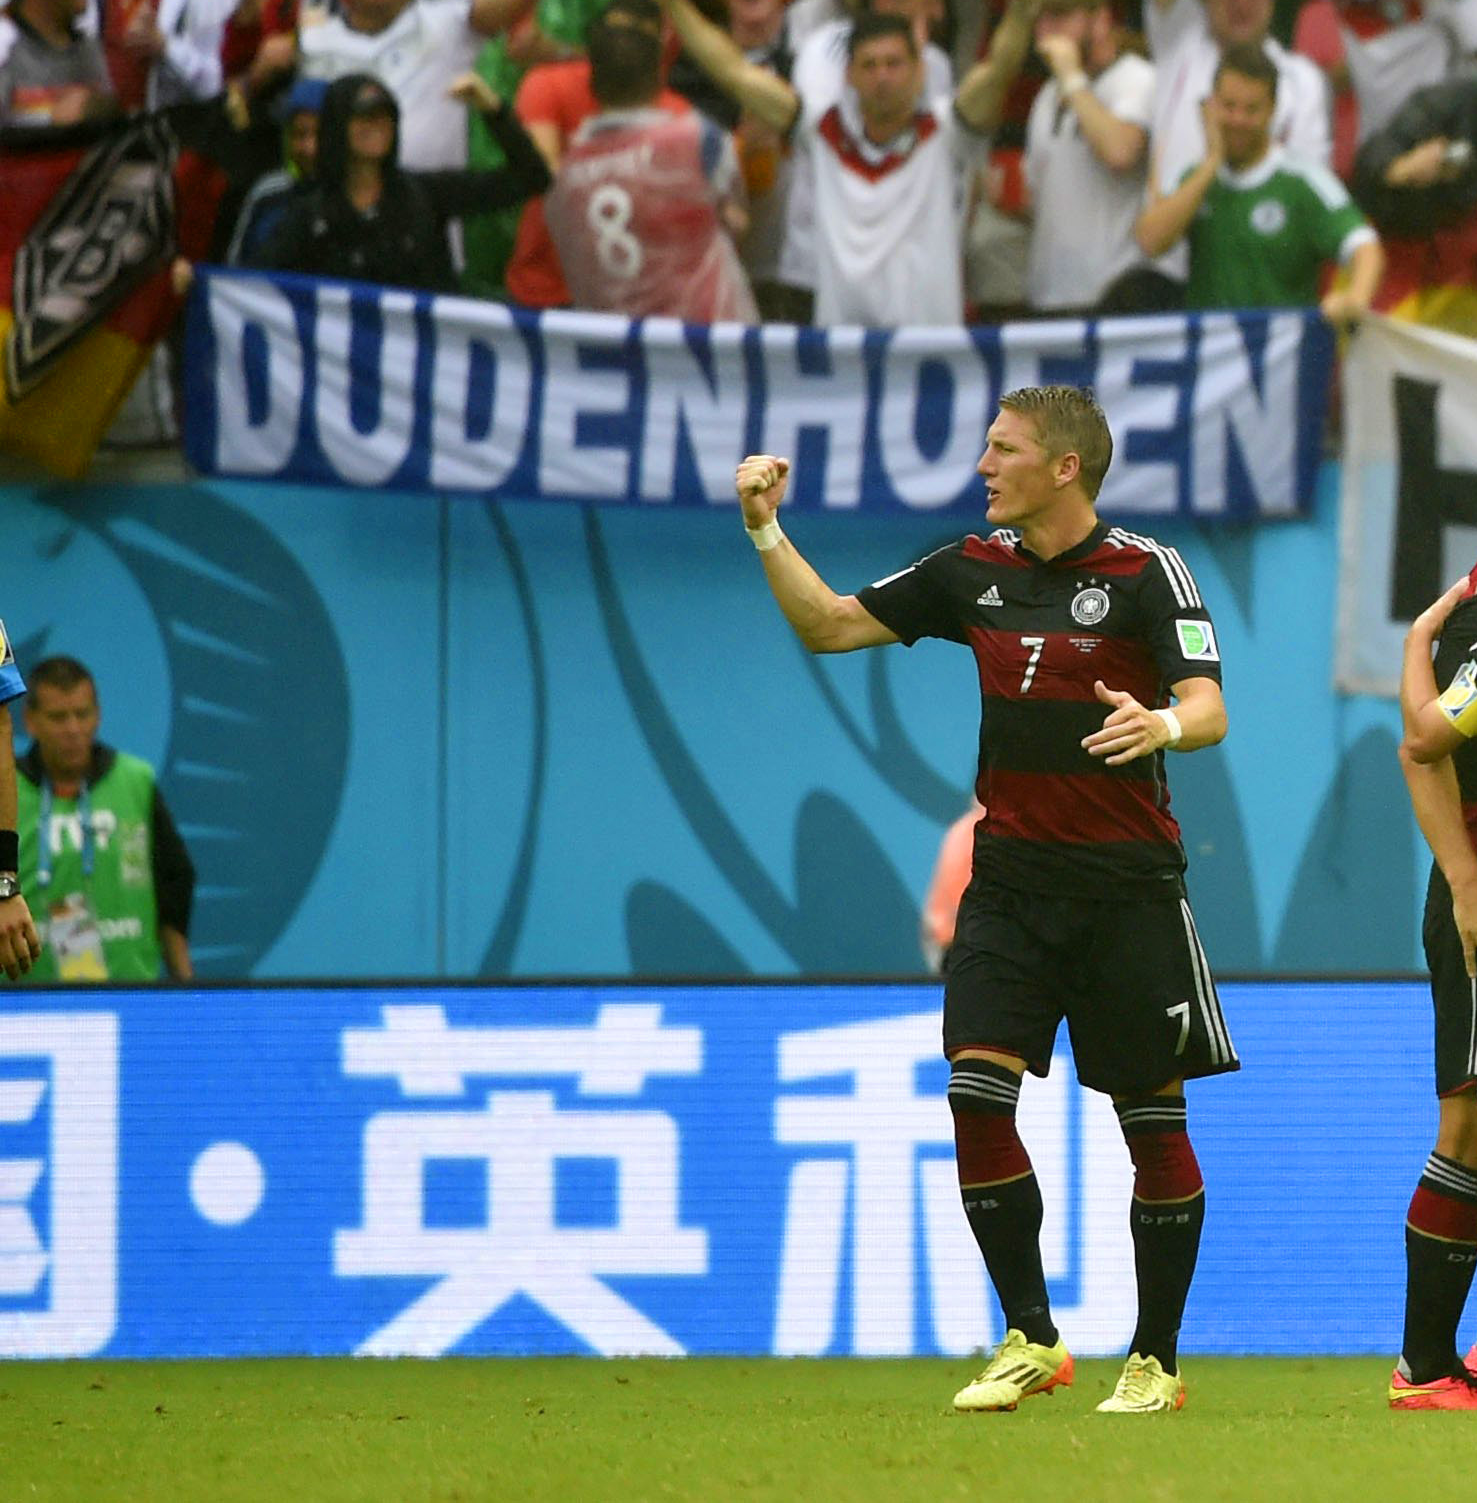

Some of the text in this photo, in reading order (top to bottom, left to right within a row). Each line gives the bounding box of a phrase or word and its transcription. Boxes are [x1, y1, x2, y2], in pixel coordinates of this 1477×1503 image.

[588, 183, 643, 279] 8
[1020, 636, 1046, 694] 7
[1165, 1000, 1191, 1056] 7
[965, 1198, 999, 1212] FB
